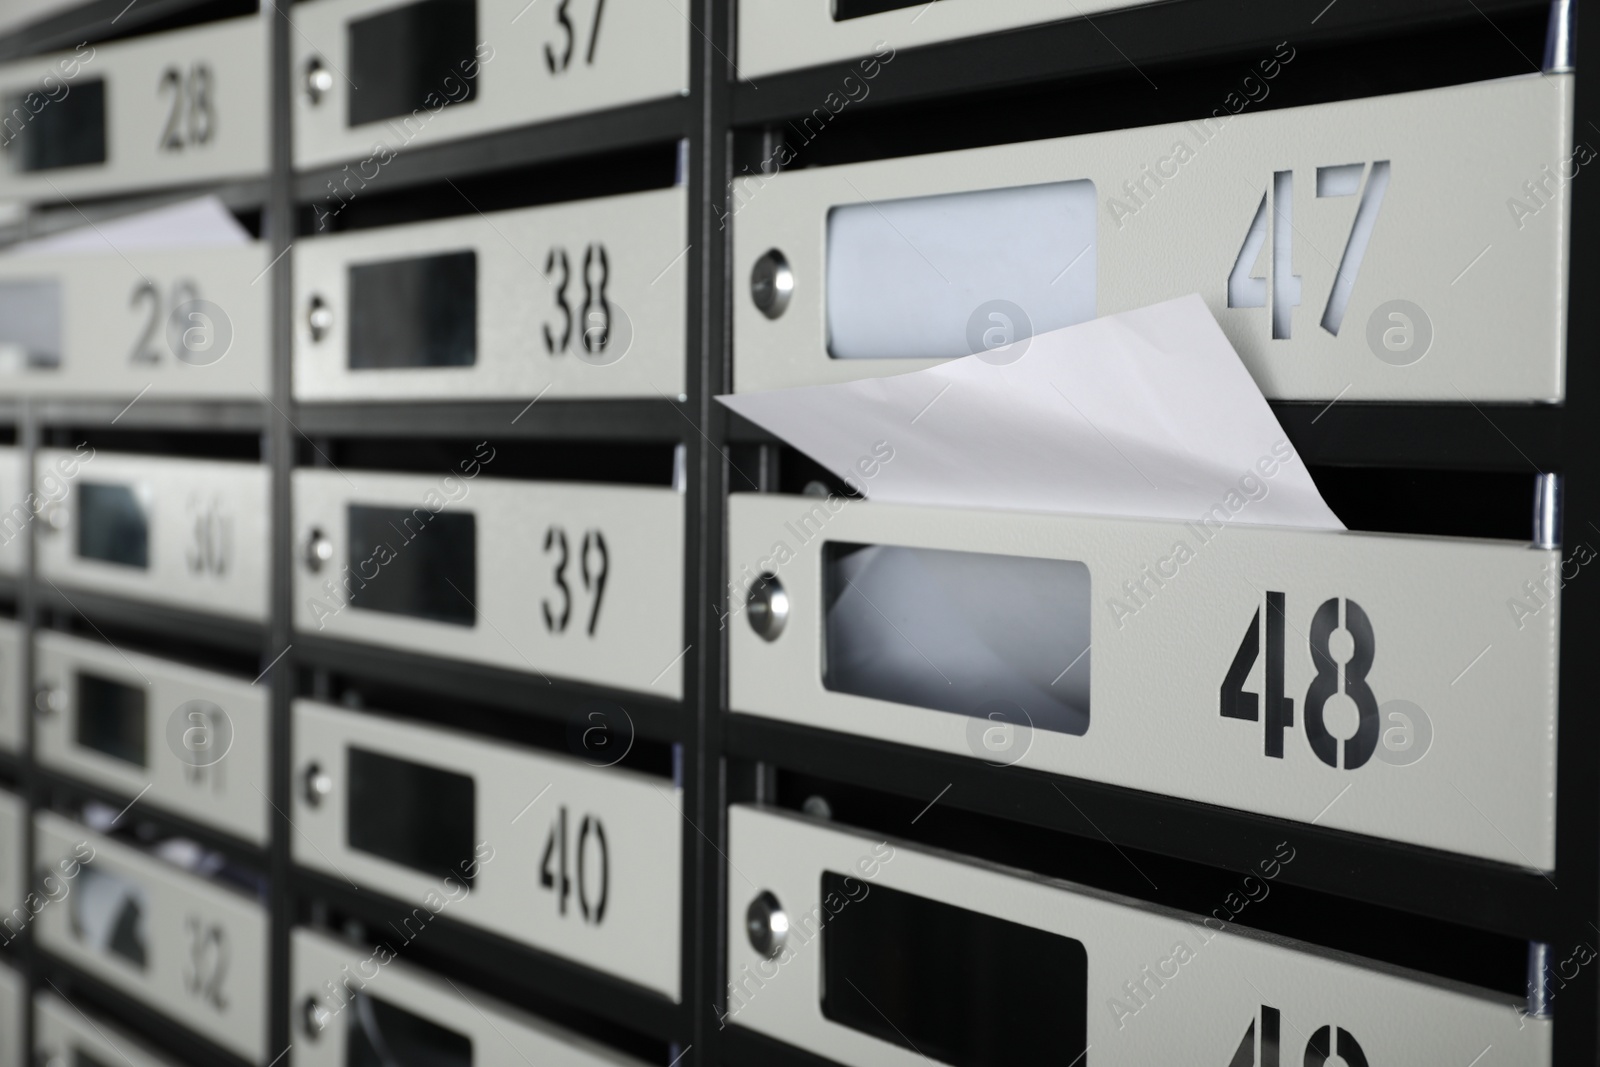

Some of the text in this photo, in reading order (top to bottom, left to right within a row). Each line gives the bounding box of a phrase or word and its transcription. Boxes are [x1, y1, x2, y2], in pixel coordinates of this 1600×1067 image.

[157, 63, 219, 152] 28
[541, 243, 611, 356] 38
[1227, 159, 1390, 340] 47
[128, 278, 203, 365] 29
[540, 526, 609, 638] 39
[1220, 590, 1380, 770] 48
[539, 804, 609, 925] 40
[181, 913, 234, 1012] 32
